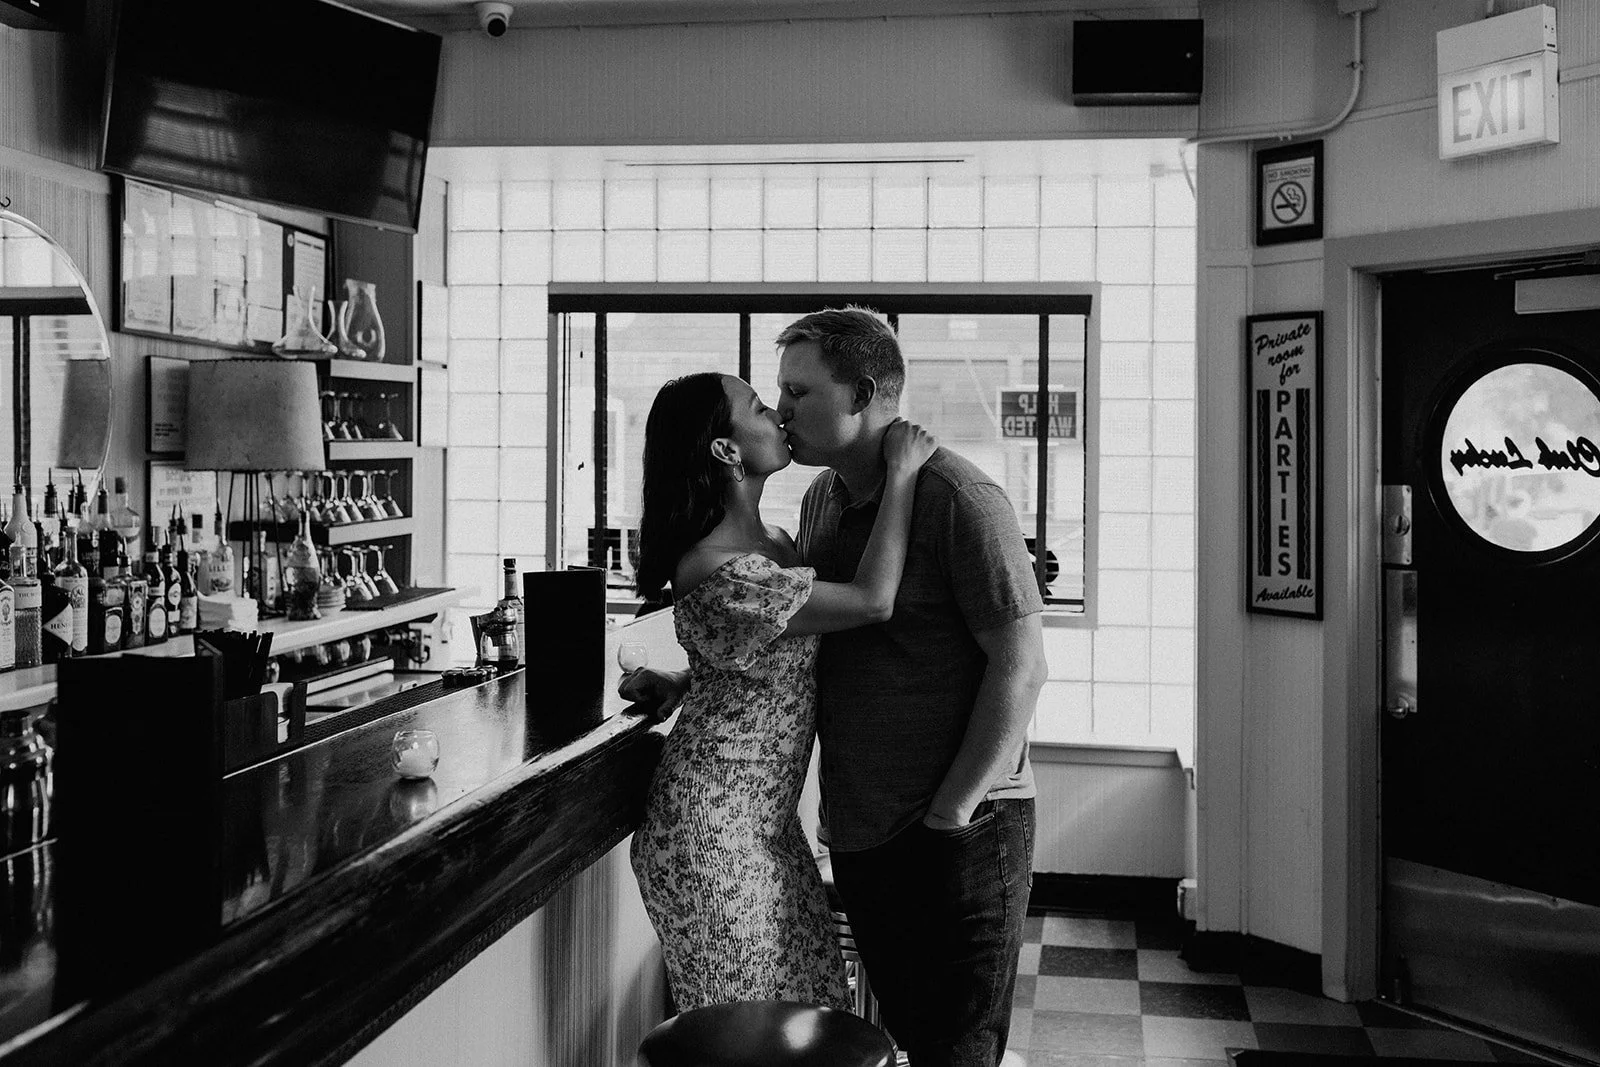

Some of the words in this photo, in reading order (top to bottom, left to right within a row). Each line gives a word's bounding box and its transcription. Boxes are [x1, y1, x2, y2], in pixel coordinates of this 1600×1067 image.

[1452, 69, 1532, 143] EXIT
[1255, 323, 1312, 356] Private
[1268, 344, 1305, 367] room
[1279, 363, 1301, 386] for
[1274, 390, 1293, 576] PARTIES
[1255, 584, 1314, 602] Available
